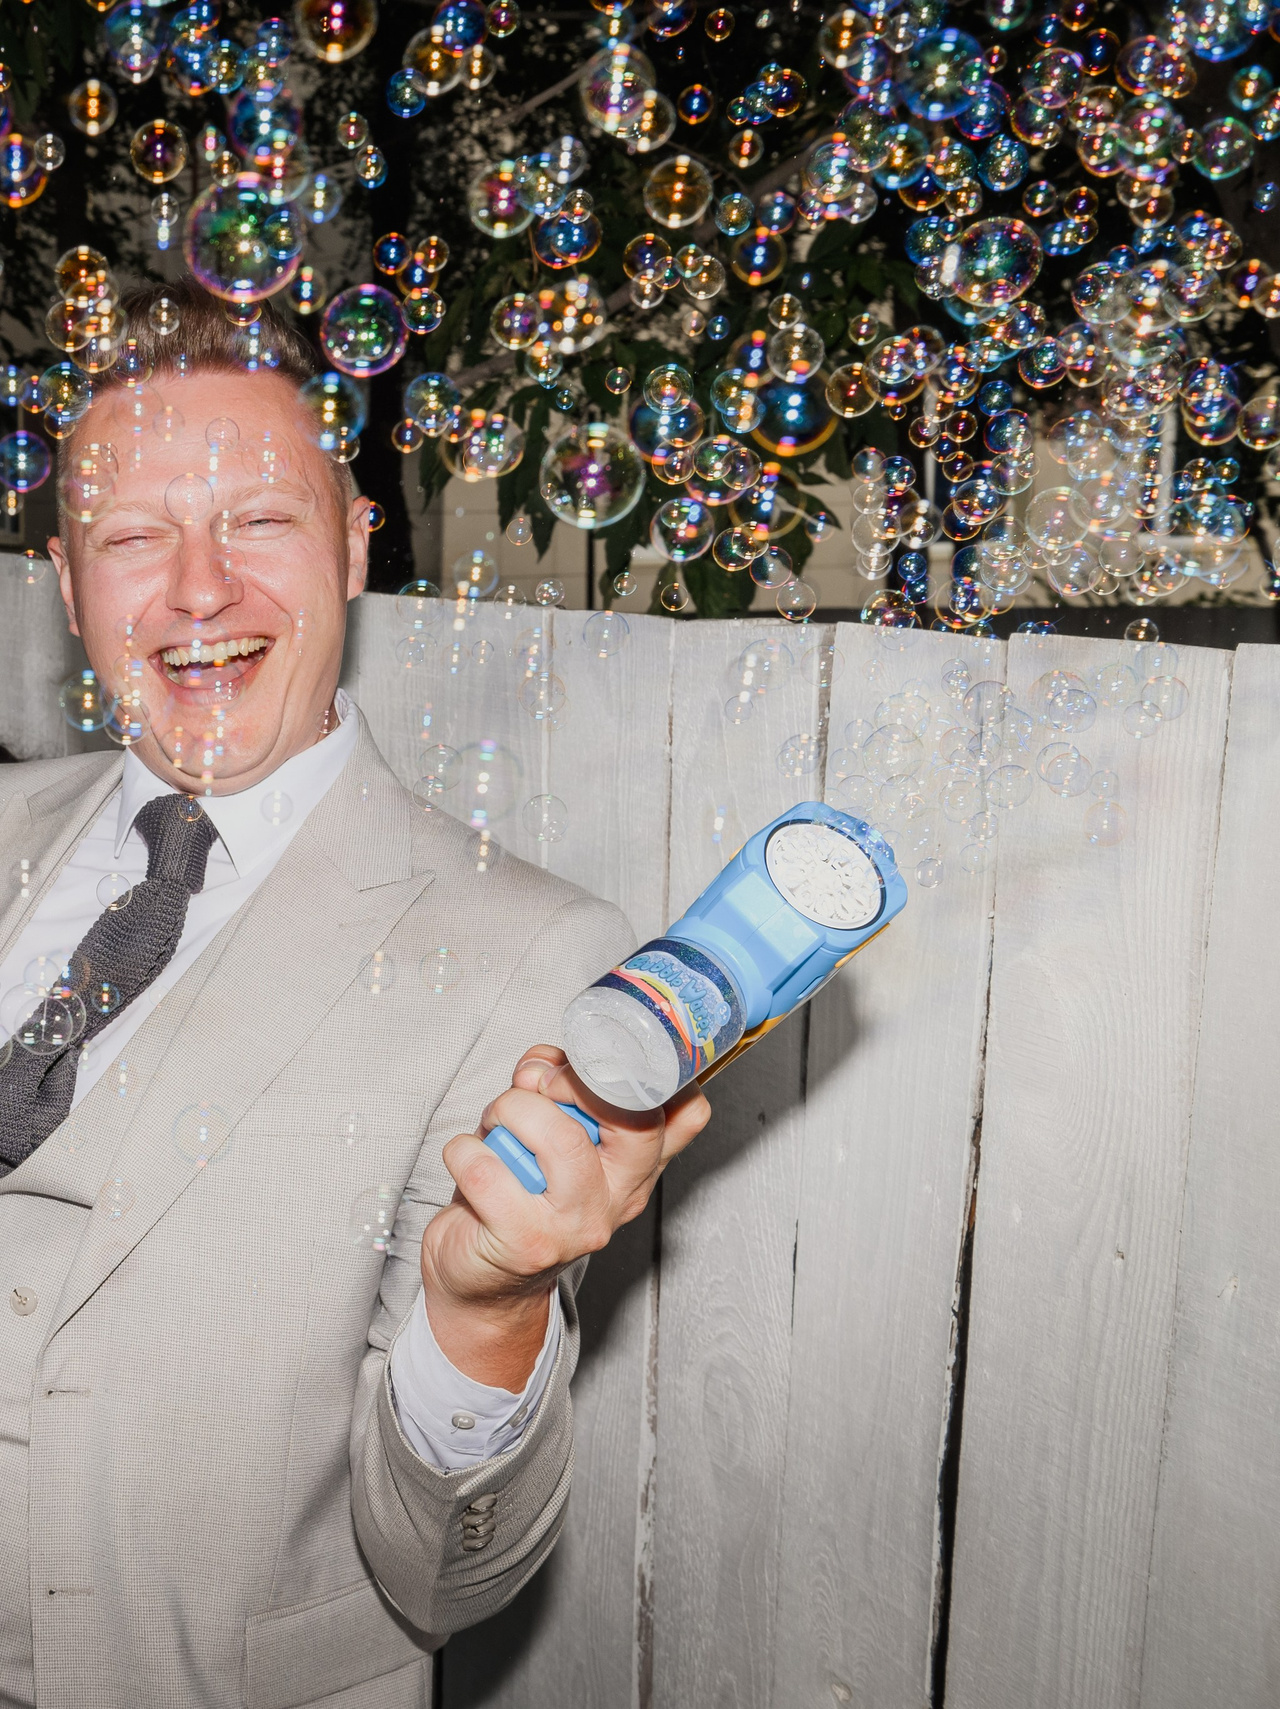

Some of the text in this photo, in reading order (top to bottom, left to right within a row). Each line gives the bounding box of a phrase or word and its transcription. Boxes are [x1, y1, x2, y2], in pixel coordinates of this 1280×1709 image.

[625, 955, 708, 1041] Bubble Water
[719, 1005, 728, 1021] 3+
